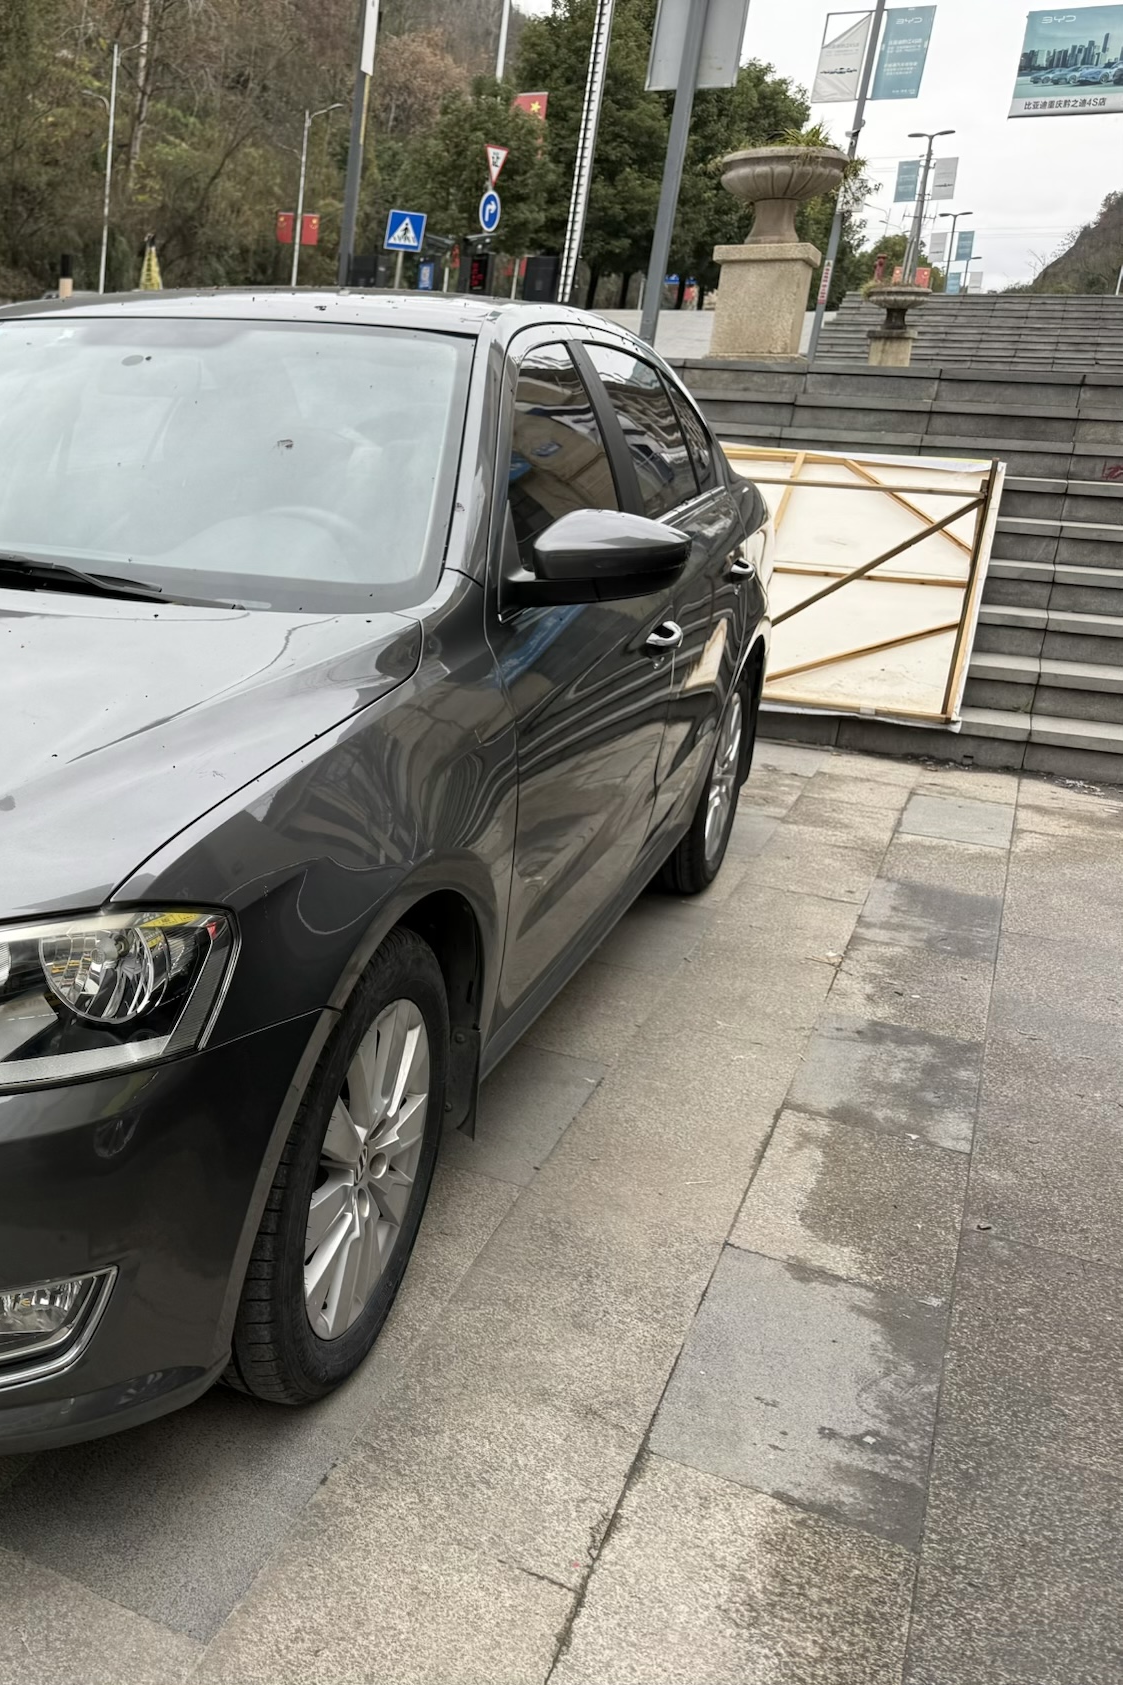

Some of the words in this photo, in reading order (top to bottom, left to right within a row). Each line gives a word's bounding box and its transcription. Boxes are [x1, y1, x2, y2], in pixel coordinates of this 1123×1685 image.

[895, 16, 923, 25] BYD
[1040, 14, 1077, 24] BYD
[1023, 97, 1107, 110] 比亚迪重庆黔之迪4S店
